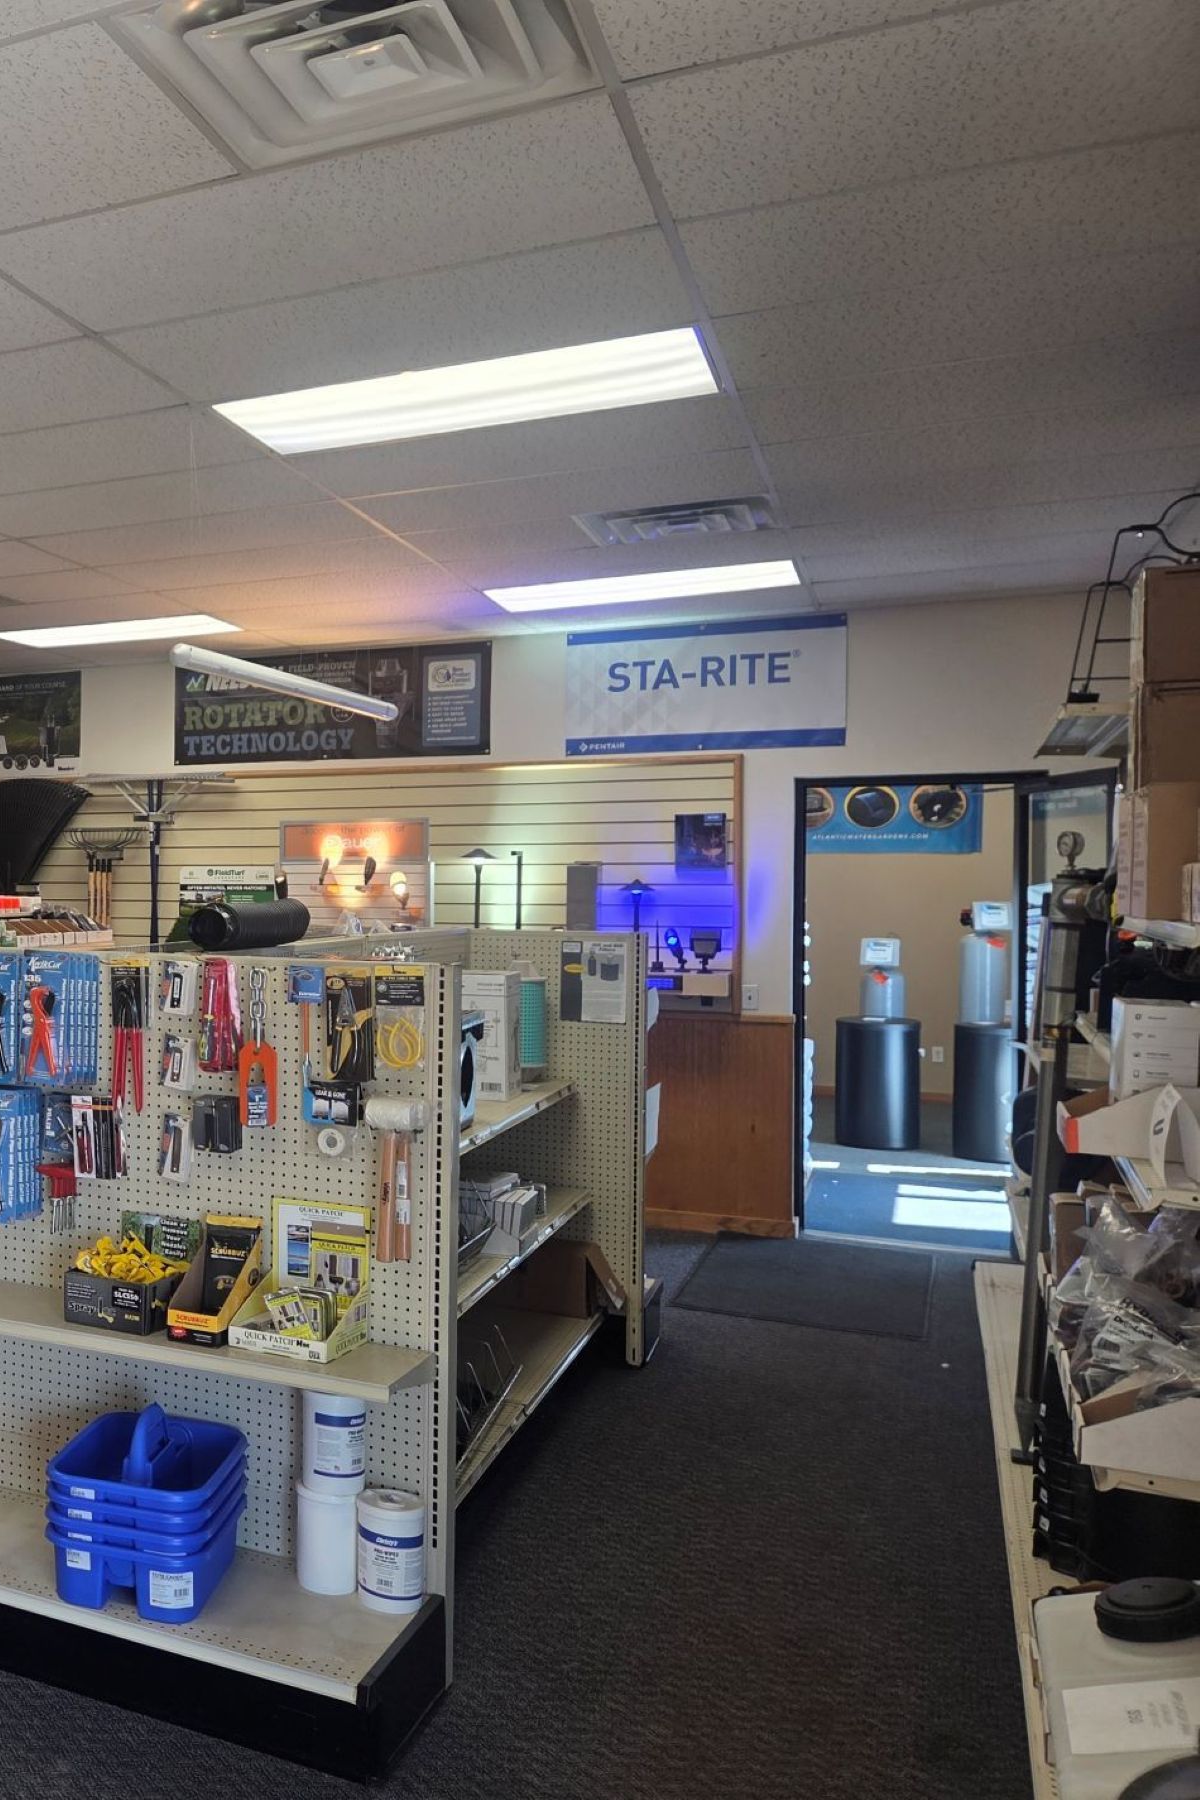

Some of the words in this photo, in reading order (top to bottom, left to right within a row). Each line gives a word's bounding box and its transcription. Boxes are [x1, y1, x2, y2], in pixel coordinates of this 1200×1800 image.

[607, 650, 791, 693] STA-RITE
[183, 699, 326, 731] ROTATOR
[183, 728, 356, 757] TECHNOLOGY
[589, 742, 625, 751] PENTAIR
[298, 1206, 320, 1214] QUICK
[244, 1331, 266, 1341] QUICK
[269, 1334, 295, 1346] PATCH
